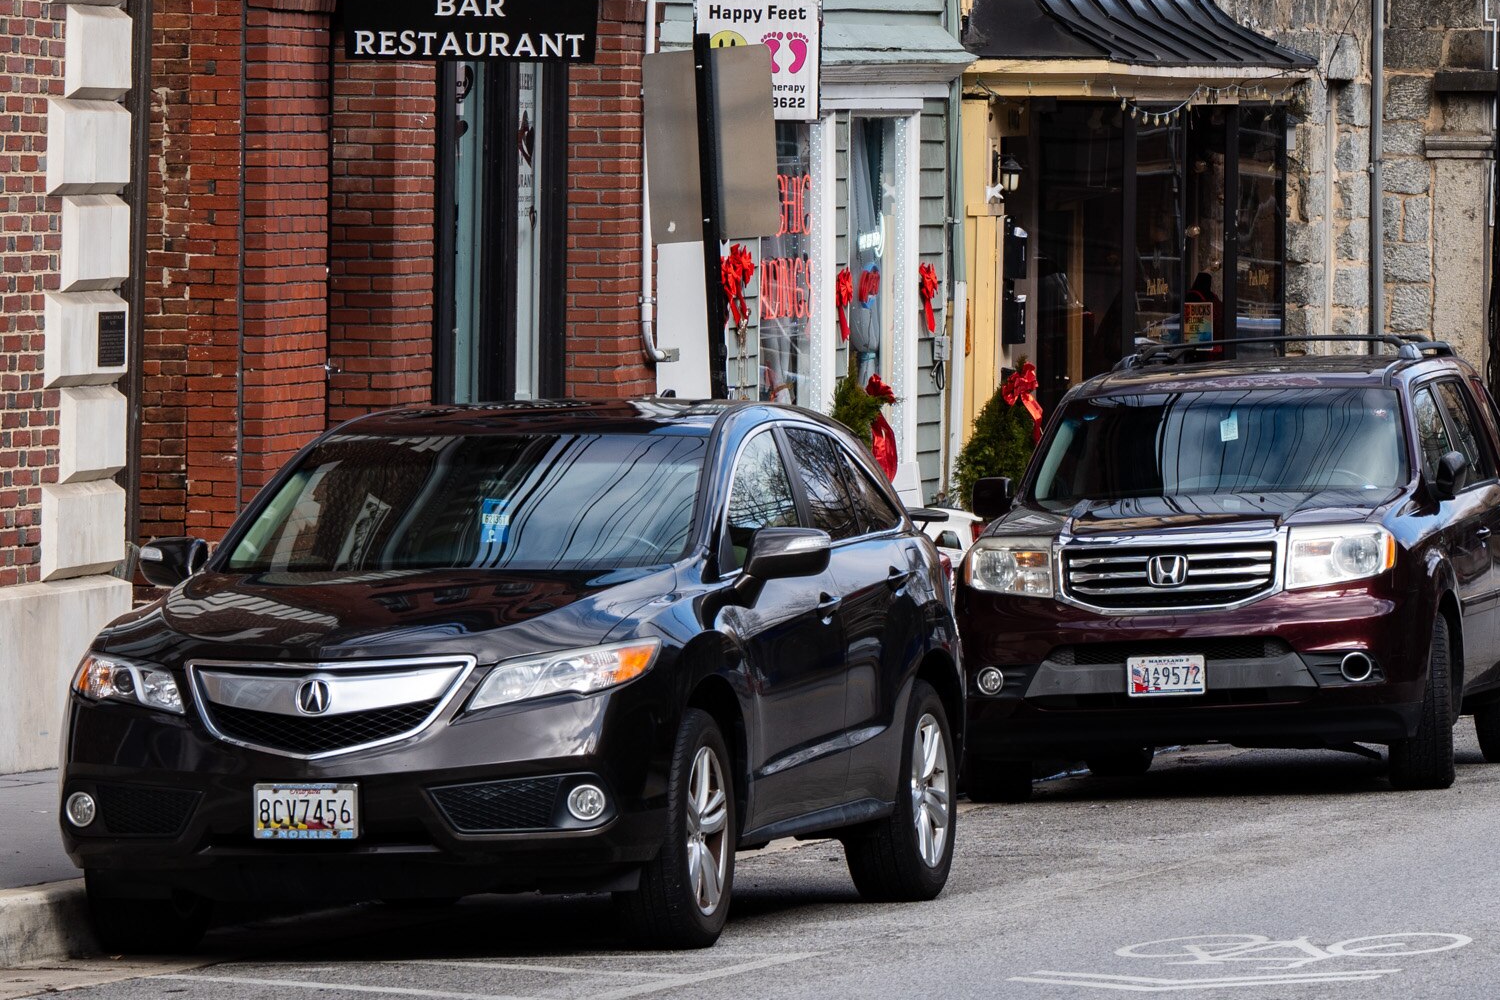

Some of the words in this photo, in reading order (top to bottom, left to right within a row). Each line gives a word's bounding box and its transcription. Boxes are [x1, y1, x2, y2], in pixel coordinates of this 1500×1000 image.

[709, 4, 763, 23] Happy
[768, 4, 807, 20] Feet
[354, 29, 586, 58] RESTAURANT
[771, 82, 806, 94] herapy
[772, 96, 806, 109] 9622
[776, 174, 813, 237] CHIC
[760, 257, 815, 319] ADINGS
[259, 798, 351, 825] 8CV7456
